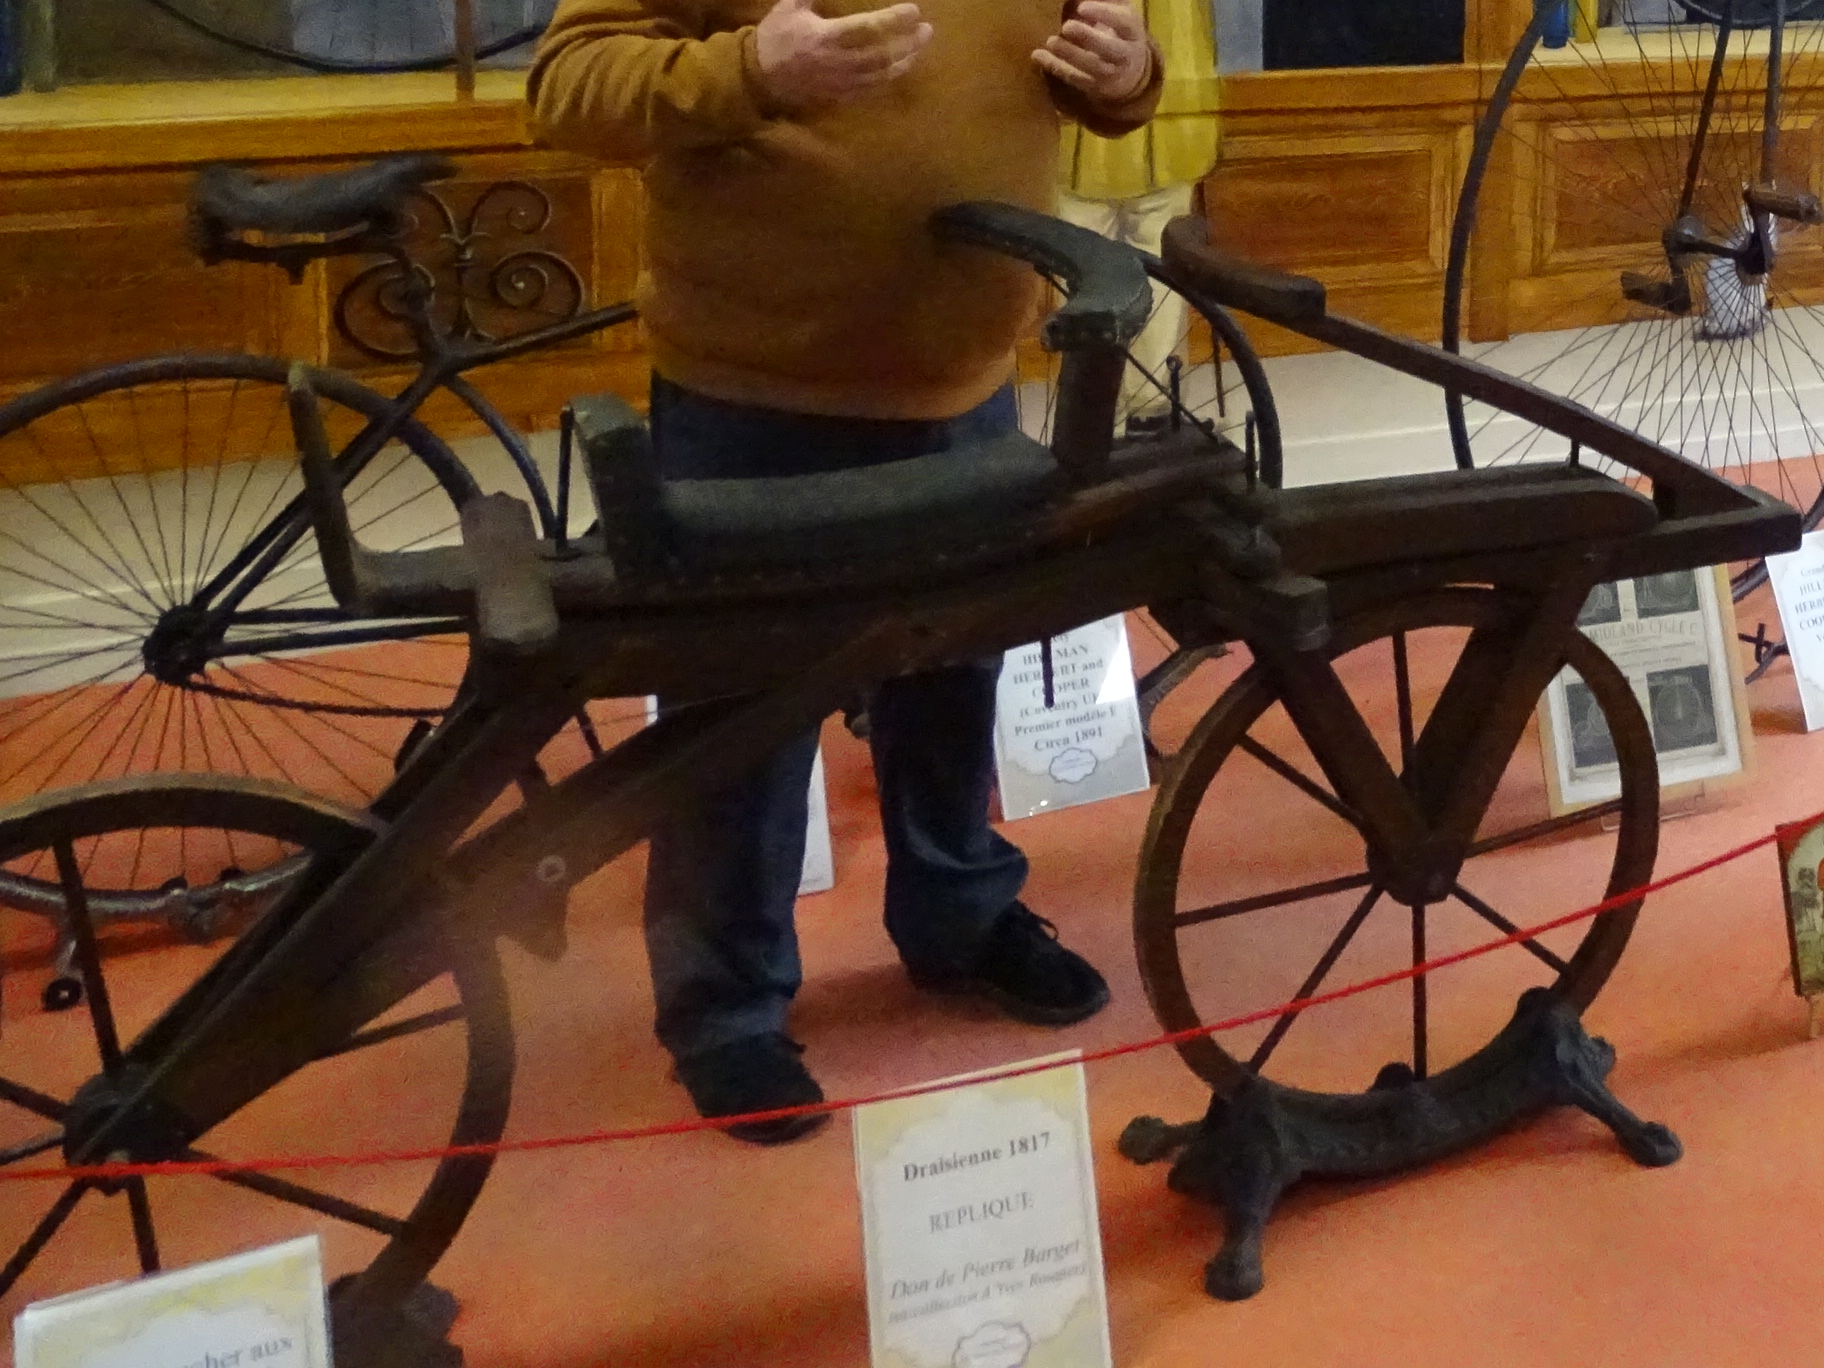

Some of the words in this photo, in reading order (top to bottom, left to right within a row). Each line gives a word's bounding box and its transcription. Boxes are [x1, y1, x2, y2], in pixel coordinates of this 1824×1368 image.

[1082, 658, 1104, 672] and
[1013, 718, 1061, 737] Premier
[1033, 736, 1070, 753] Circa
[902, 1146, 1003, 1183] Draisienne
[1008, 1131, 1051, 1159] 1817
[962, 1256, 1016, 1283] Pierre
